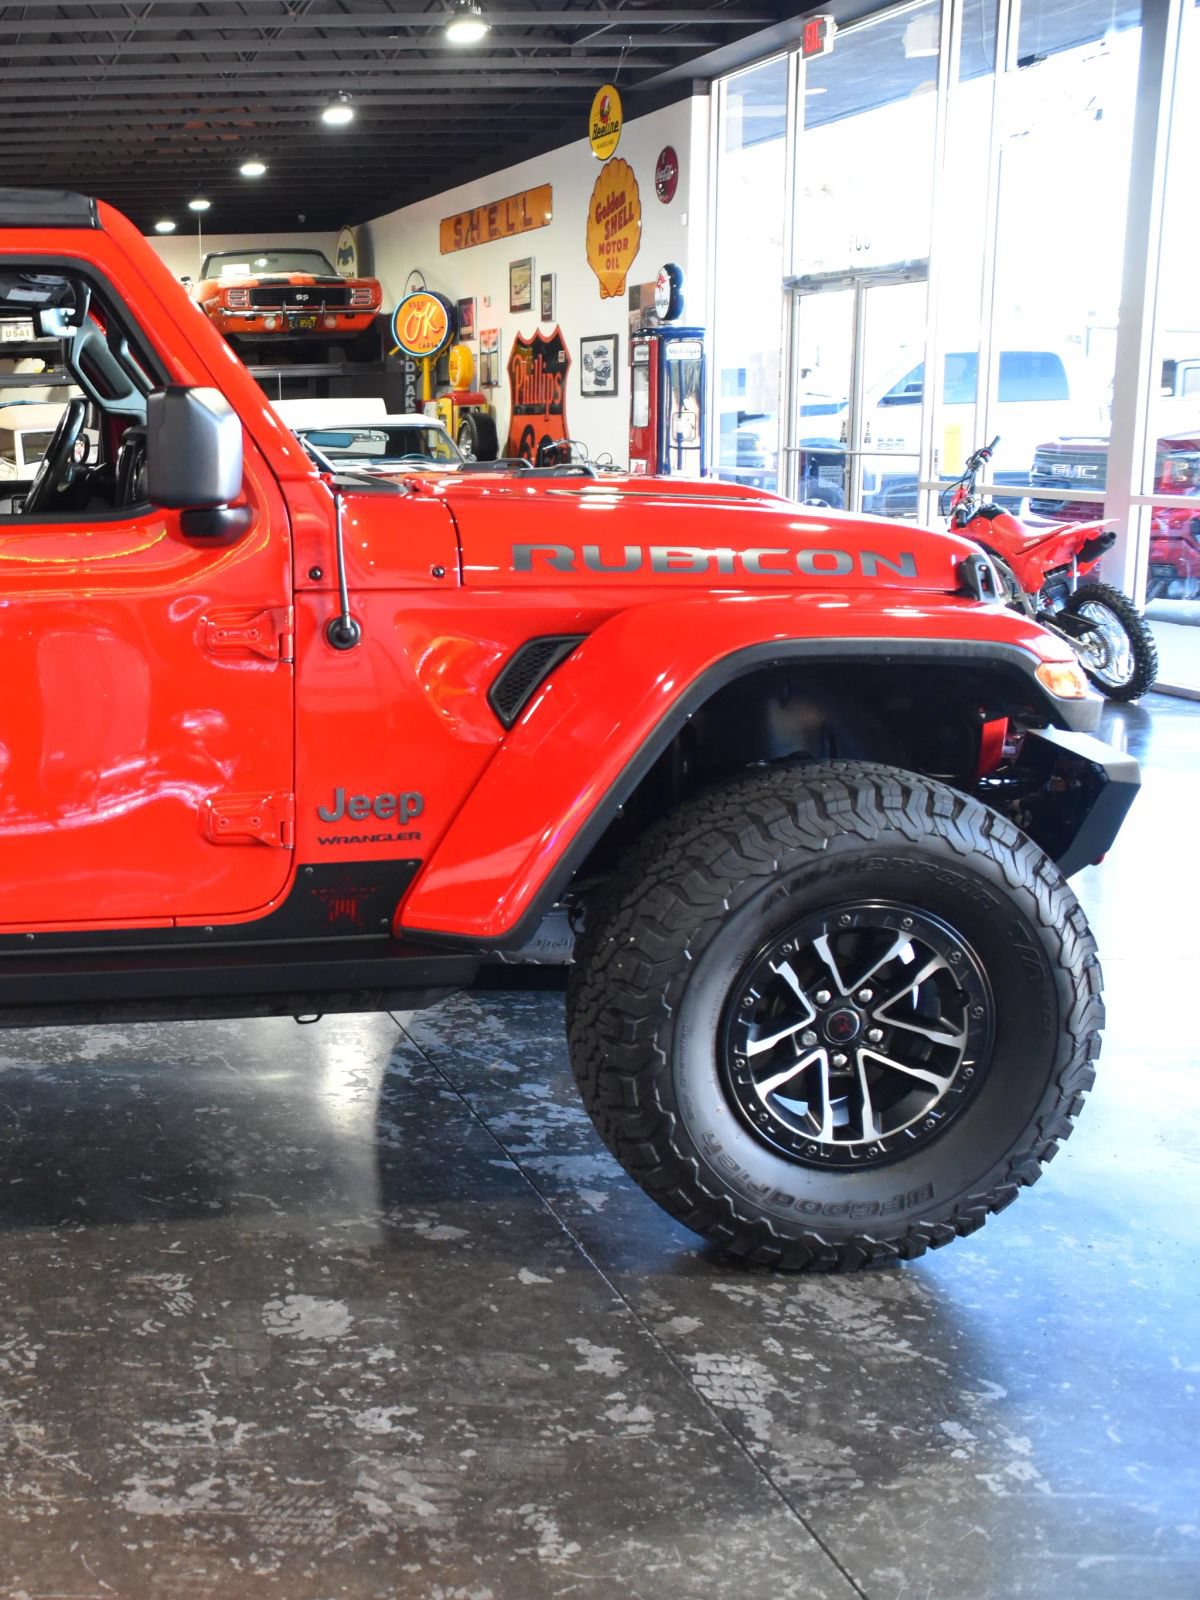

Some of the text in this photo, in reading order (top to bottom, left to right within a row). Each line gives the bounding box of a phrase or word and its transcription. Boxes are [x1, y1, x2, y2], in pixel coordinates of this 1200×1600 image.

[454, 196, 533, 248] SHELL
[596, 190, 626, 224] Golden
[604, 201, 634, 241] SHELL
[598, 237, 629, 256] MOTOR
[605, 258, 620, 270] OIL
[5, 329, 30, 338] USA1
[405, 302, 444, 344] OK
[405, 361, 417, 407] DPAK
[513, 352, 562, 421] Phillips
[1052, 464, 1098, 479] GMC
[511, 544, 918, 578] RUBICON
[318, 787, 424, 825] Jeep
[317, 831, 422, 845] WRANGLER
